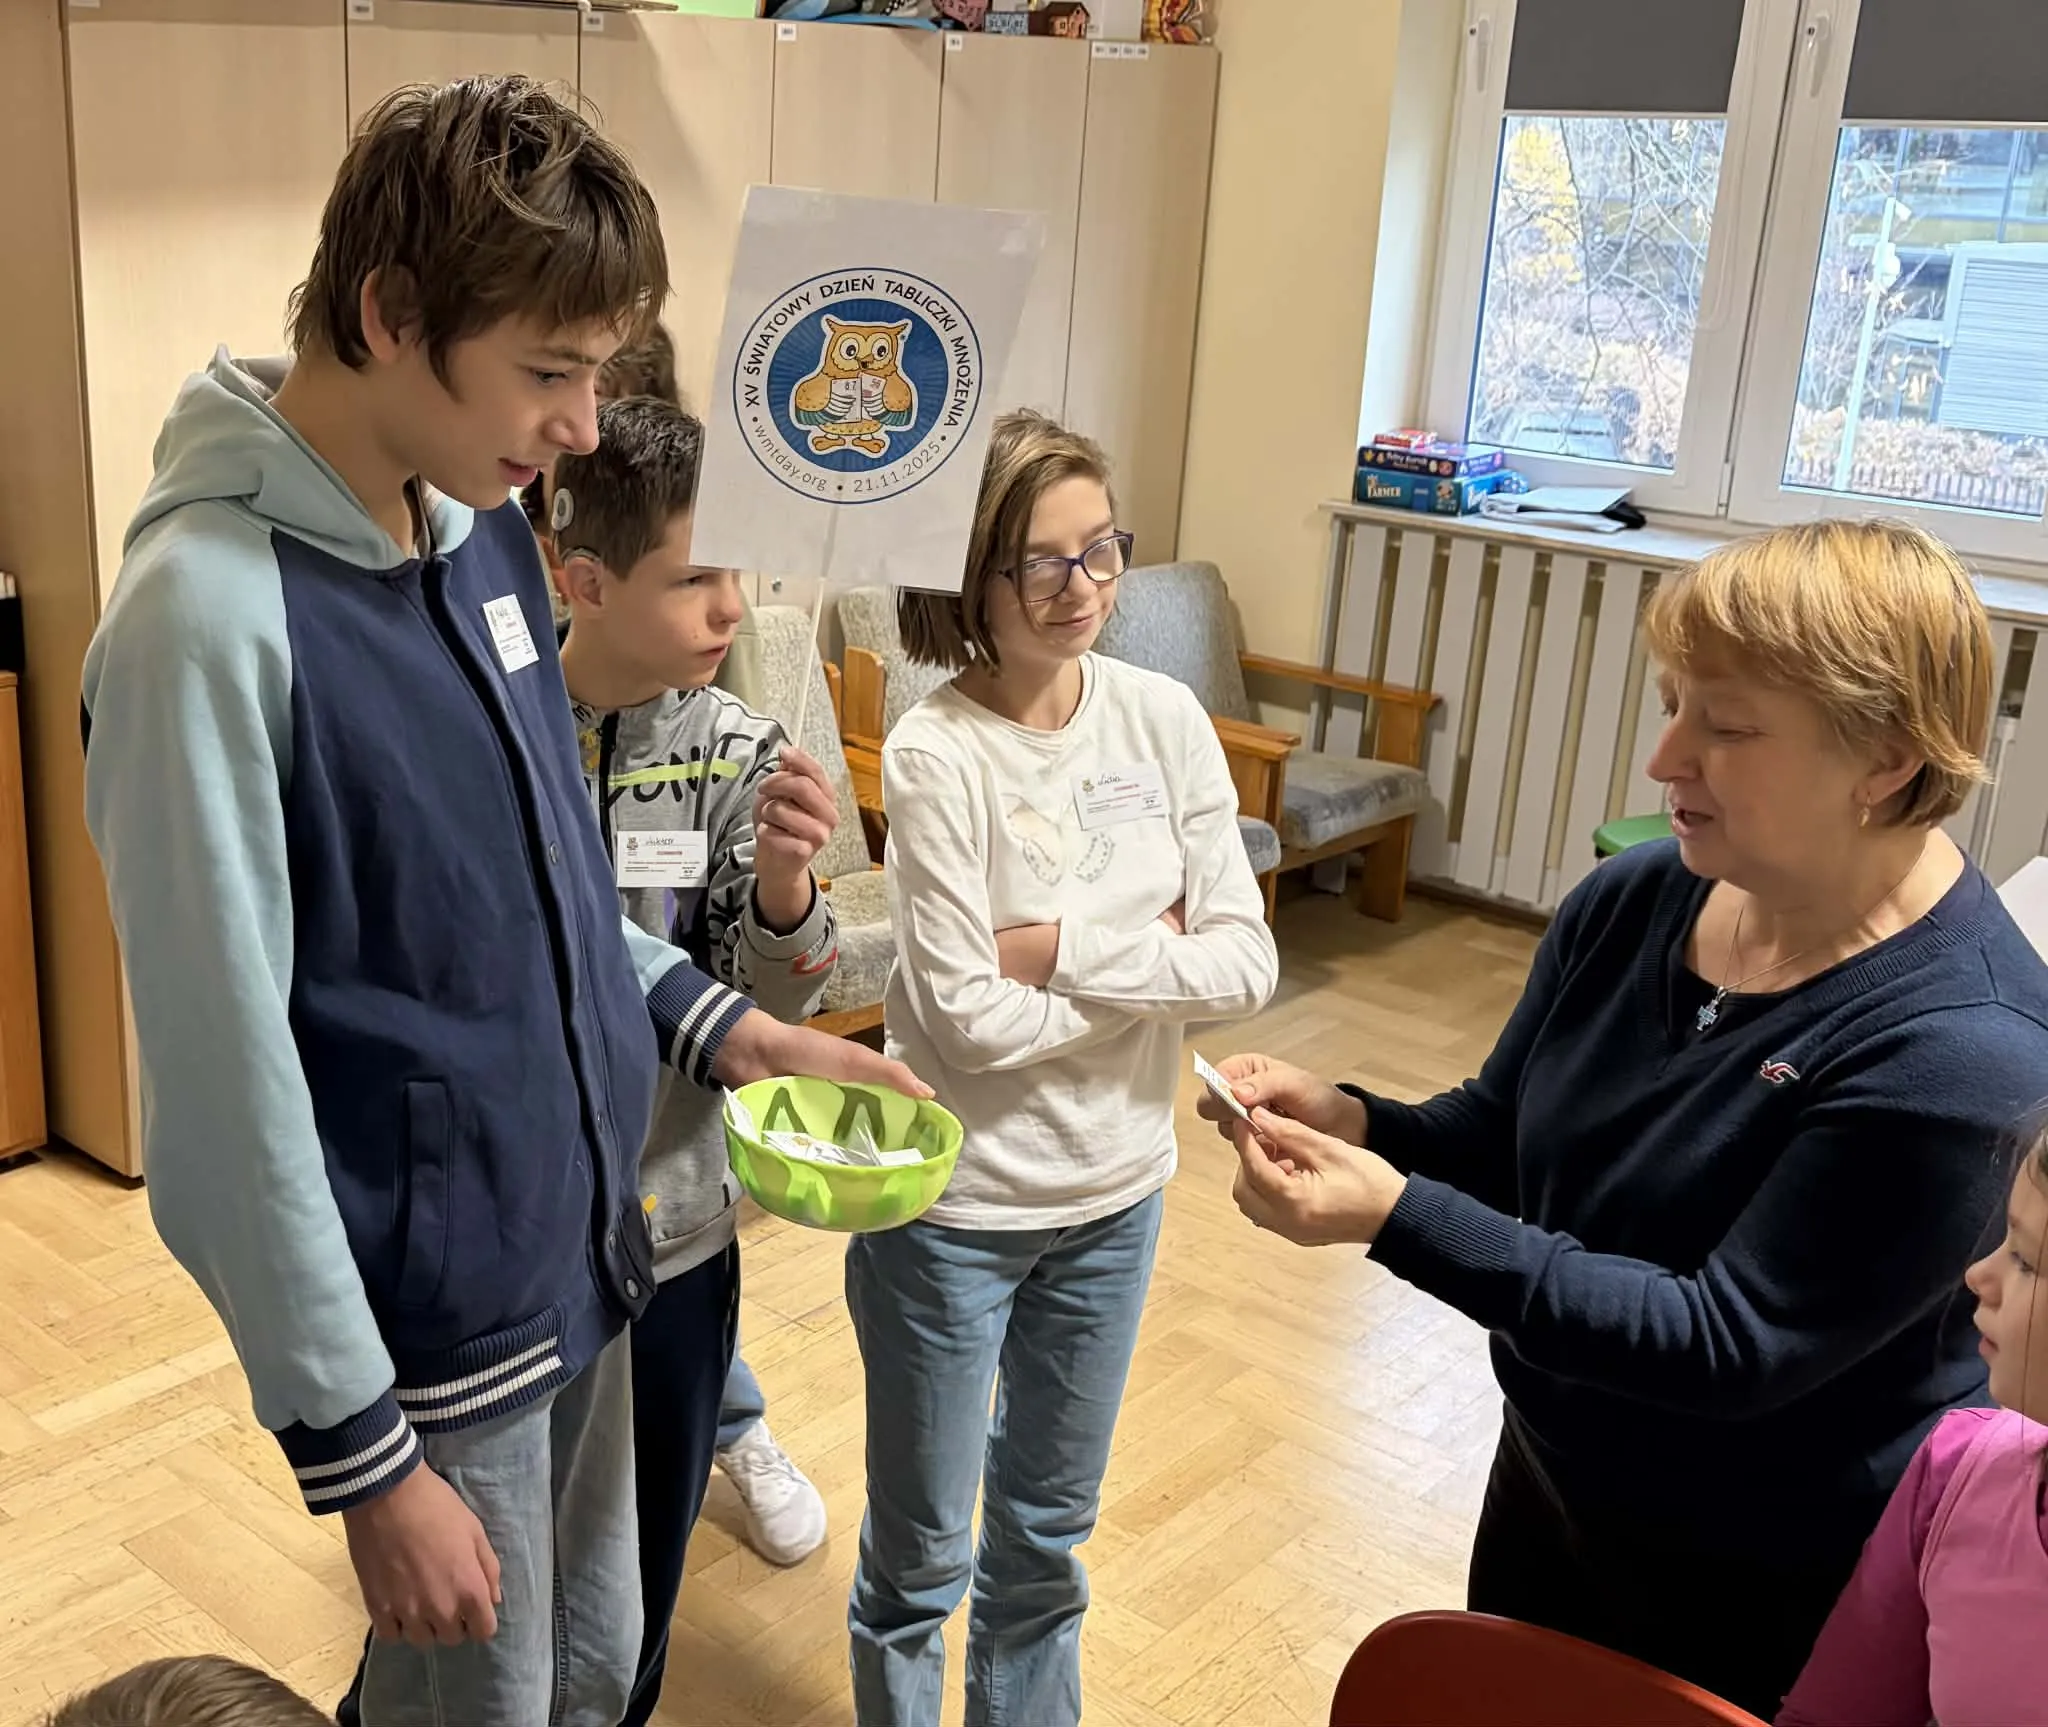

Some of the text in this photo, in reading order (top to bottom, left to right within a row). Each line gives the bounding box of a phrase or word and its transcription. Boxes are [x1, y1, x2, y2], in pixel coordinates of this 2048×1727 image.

[743, 275, 974, 427] XV ŚWIATOWY DZIEŃ TABLICZKI MNOŻENIA
[754, 425, 827, 492] wmtday.org
[854, 440, 941, 493] 21.11.2025
